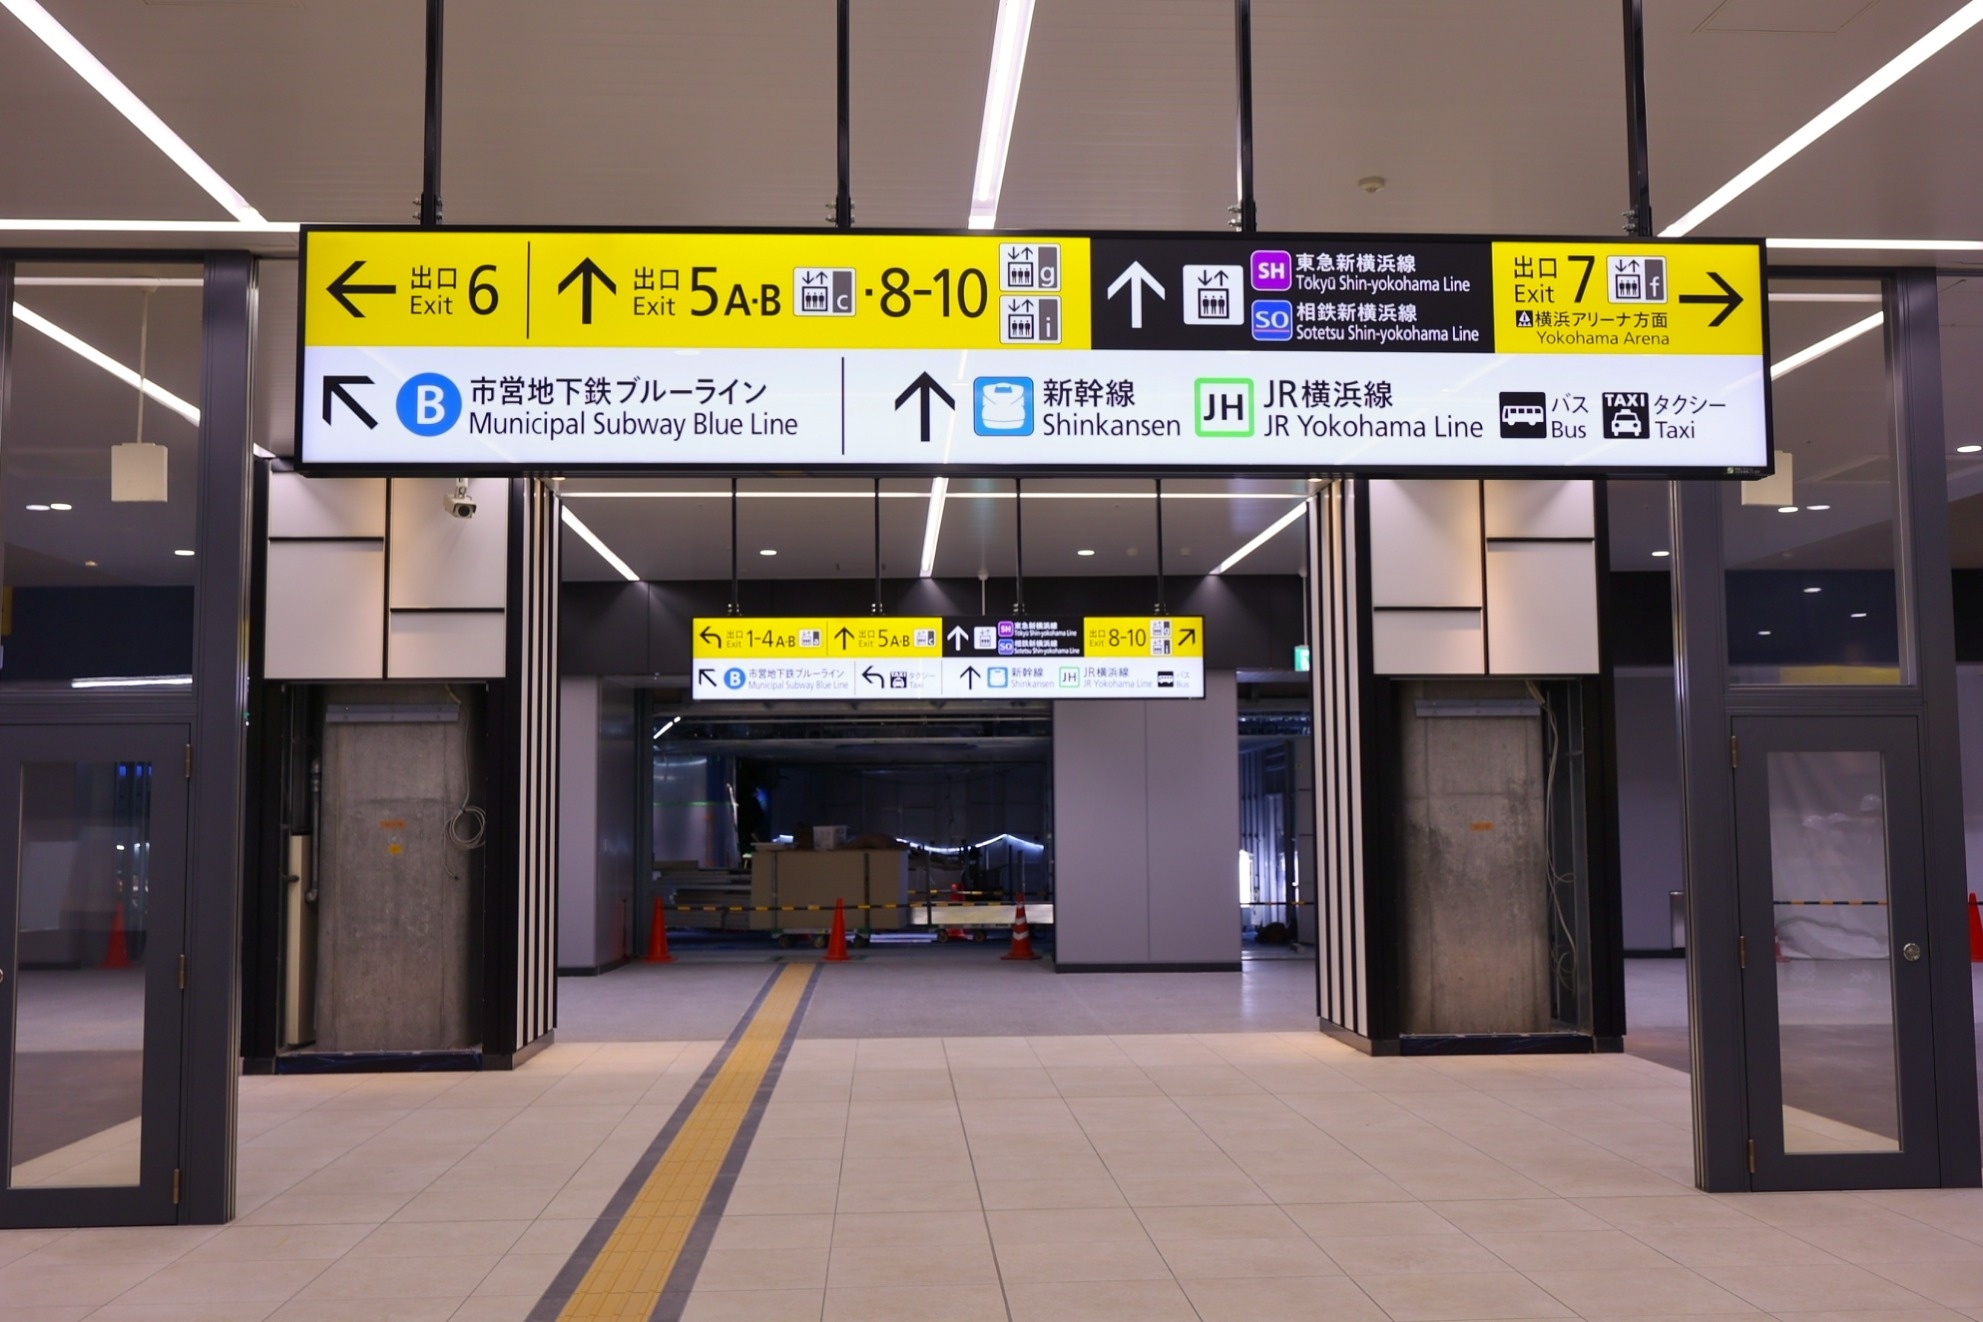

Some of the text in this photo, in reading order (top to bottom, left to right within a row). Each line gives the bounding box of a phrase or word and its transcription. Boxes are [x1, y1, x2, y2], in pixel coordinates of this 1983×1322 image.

[1258, 260, 1285, 279] SH
[1296, 252, 1416, 273] 東急新横浜線
[1514, 255, 1557, 279] 出口
[411, 266, 457, 288] 出口
[634, 268, 679, 290] 出口
[1040, 265, 1054, 286] g
[1296, 273, 1470, 292] Tōkyū Shin-yokohama Line
[1567, 255, 1595, 302] 7
[1650, 275, 1660, 296] f
[468, 264, 499, 315] 6
[1515, 282, 1554, 303] Exit
[411, 294, 452, 315] Exit
[634, 296, 675, 316] Exit
[1297, 302, 1417, 322] 相鉄新横浜線
[1046, 316, 1050, 336] i
[1256, 309, 1288, 329] SO
[1536, 310, 1667, 329] 横浜アリーナ方面
[1297, 323, 1479, 343] Sotetsu Shin-yokohama Line
[1538, 330, 1669, 346] Yokohama Arena
[470, 375, 768, 405] 市営地下鉄ブルーライン
[1043, 378, 1135, 406] 新幹線
[1264, 379, 1393, 408] JR横浜線
[1605, 393, 1645, 406] TAXI
[415, 384, 445, 423] B
[1204, 394, 1242, 421] JH
[1552, 394, 1588, 414] バス
[1653, 394, 1726, 414] タクシー
[470, 411, 798, 440] Municipal Subway Blue Line
[1043, 412, 1181, 437] Shinkansen
[1264, 413, 1483, 439] JR Yokohama Line
[1552, 421, 1586, 439] Bus
[1657, 421, 1695, 439] Taxi
[727, 630, 743, 638] 出口
[727, 640, 741, 648] Exit
[859, 630, 874, 638] 出口
[1089, 630, 1105, 638] 出口
[1089, 639, 1104, 647] Exit
[1109, 629, 1145, 646] 8-10
[1000, 643, 1012, 651] SO
[730, 672, 739, 685] B
[749, 669, 844, 678] 市営地下鉄ブルーライン
[1012, 667, 1043, 677] 新幹線
[1063, 673, 1076, 682] JH
[1084, 667, 1128, 678] JR横浜線
[749, 681, 783, 689] Municipal
[786, 681, 814, 690] Subway
[1012, 679, 1054, 687] Shinkansen
[1084, 679, 1153, 688] JR Yokohama Line
